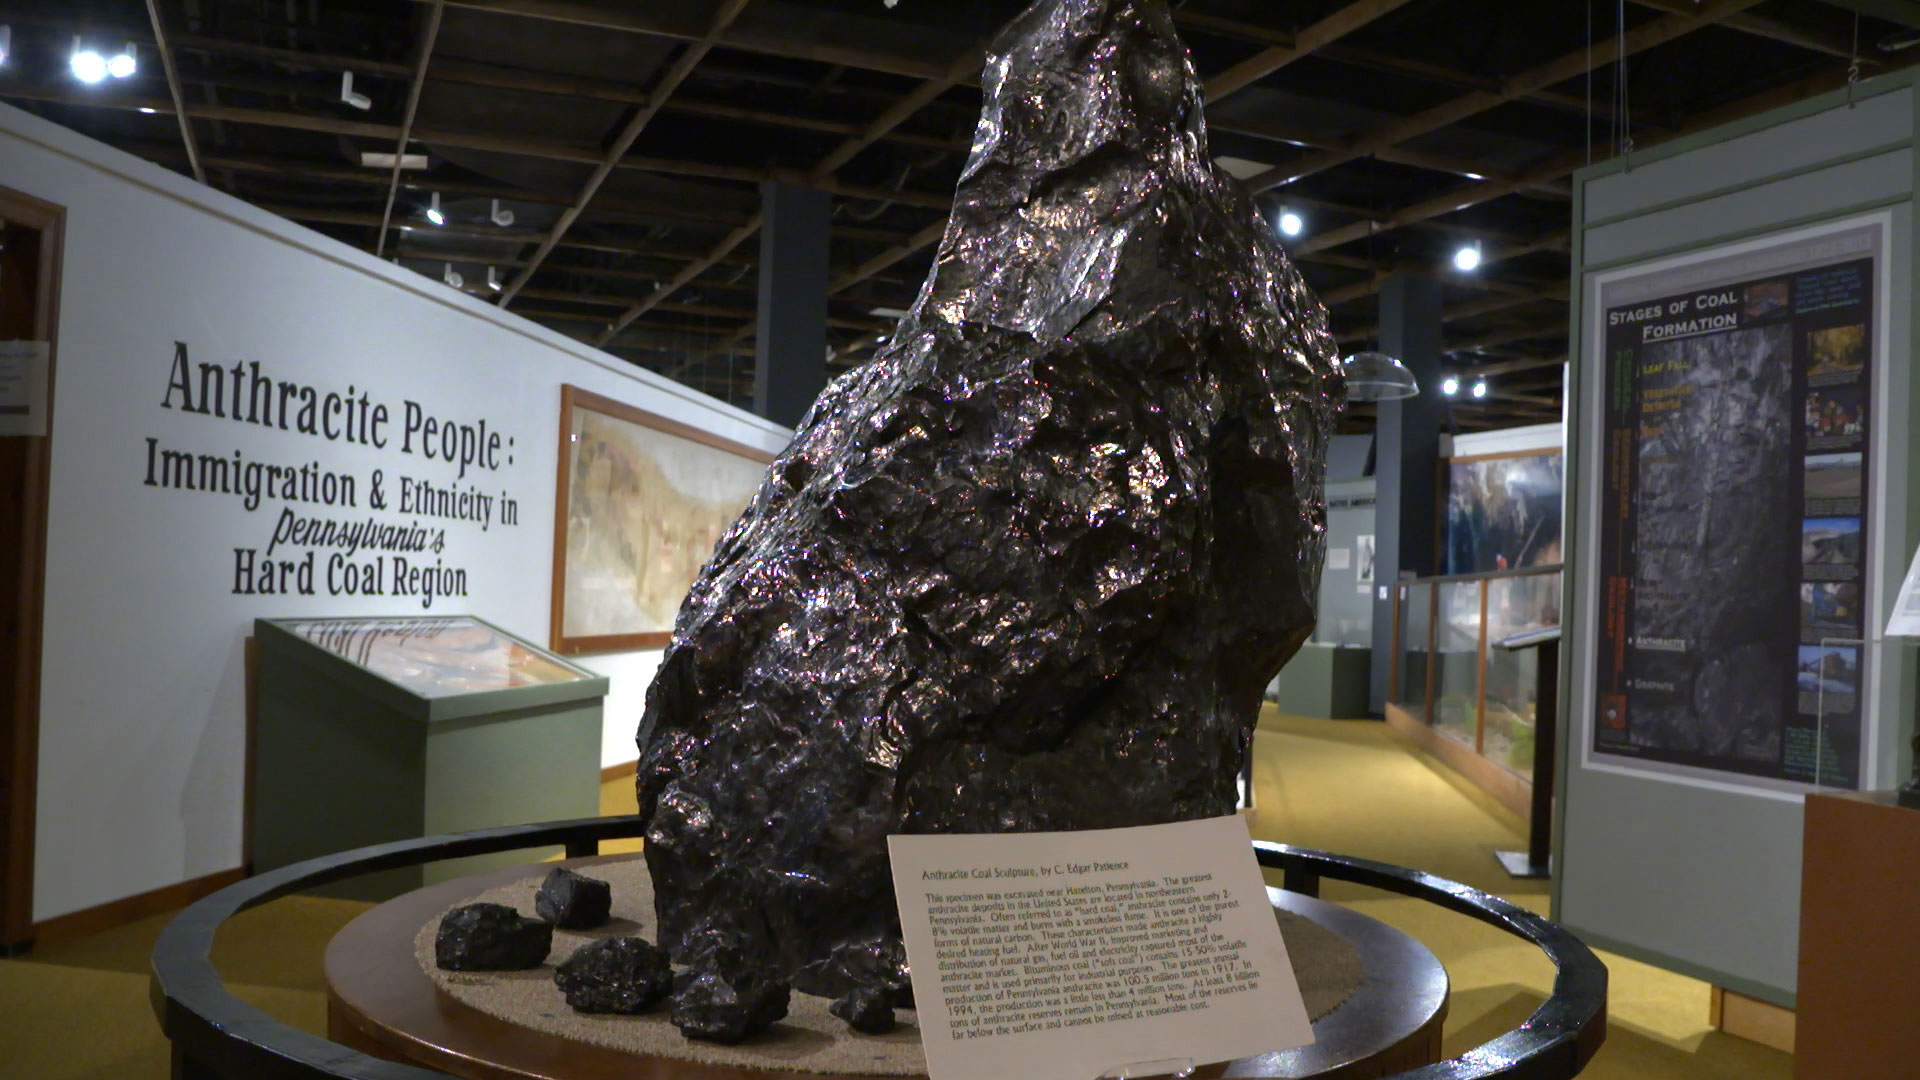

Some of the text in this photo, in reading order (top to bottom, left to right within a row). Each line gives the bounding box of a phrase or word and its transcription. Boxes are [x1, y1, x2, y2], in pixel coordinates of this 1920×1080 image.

[160, 342, 514, 479] Anthracite People:
[143, 438, 518, 531] Immigration & Ethnicity in
[233, 548, 468, 608] Hard Coal Region
[921, 861, 1129, 878] Anthracite Coal Sculpture, by C. Edgar Patience
